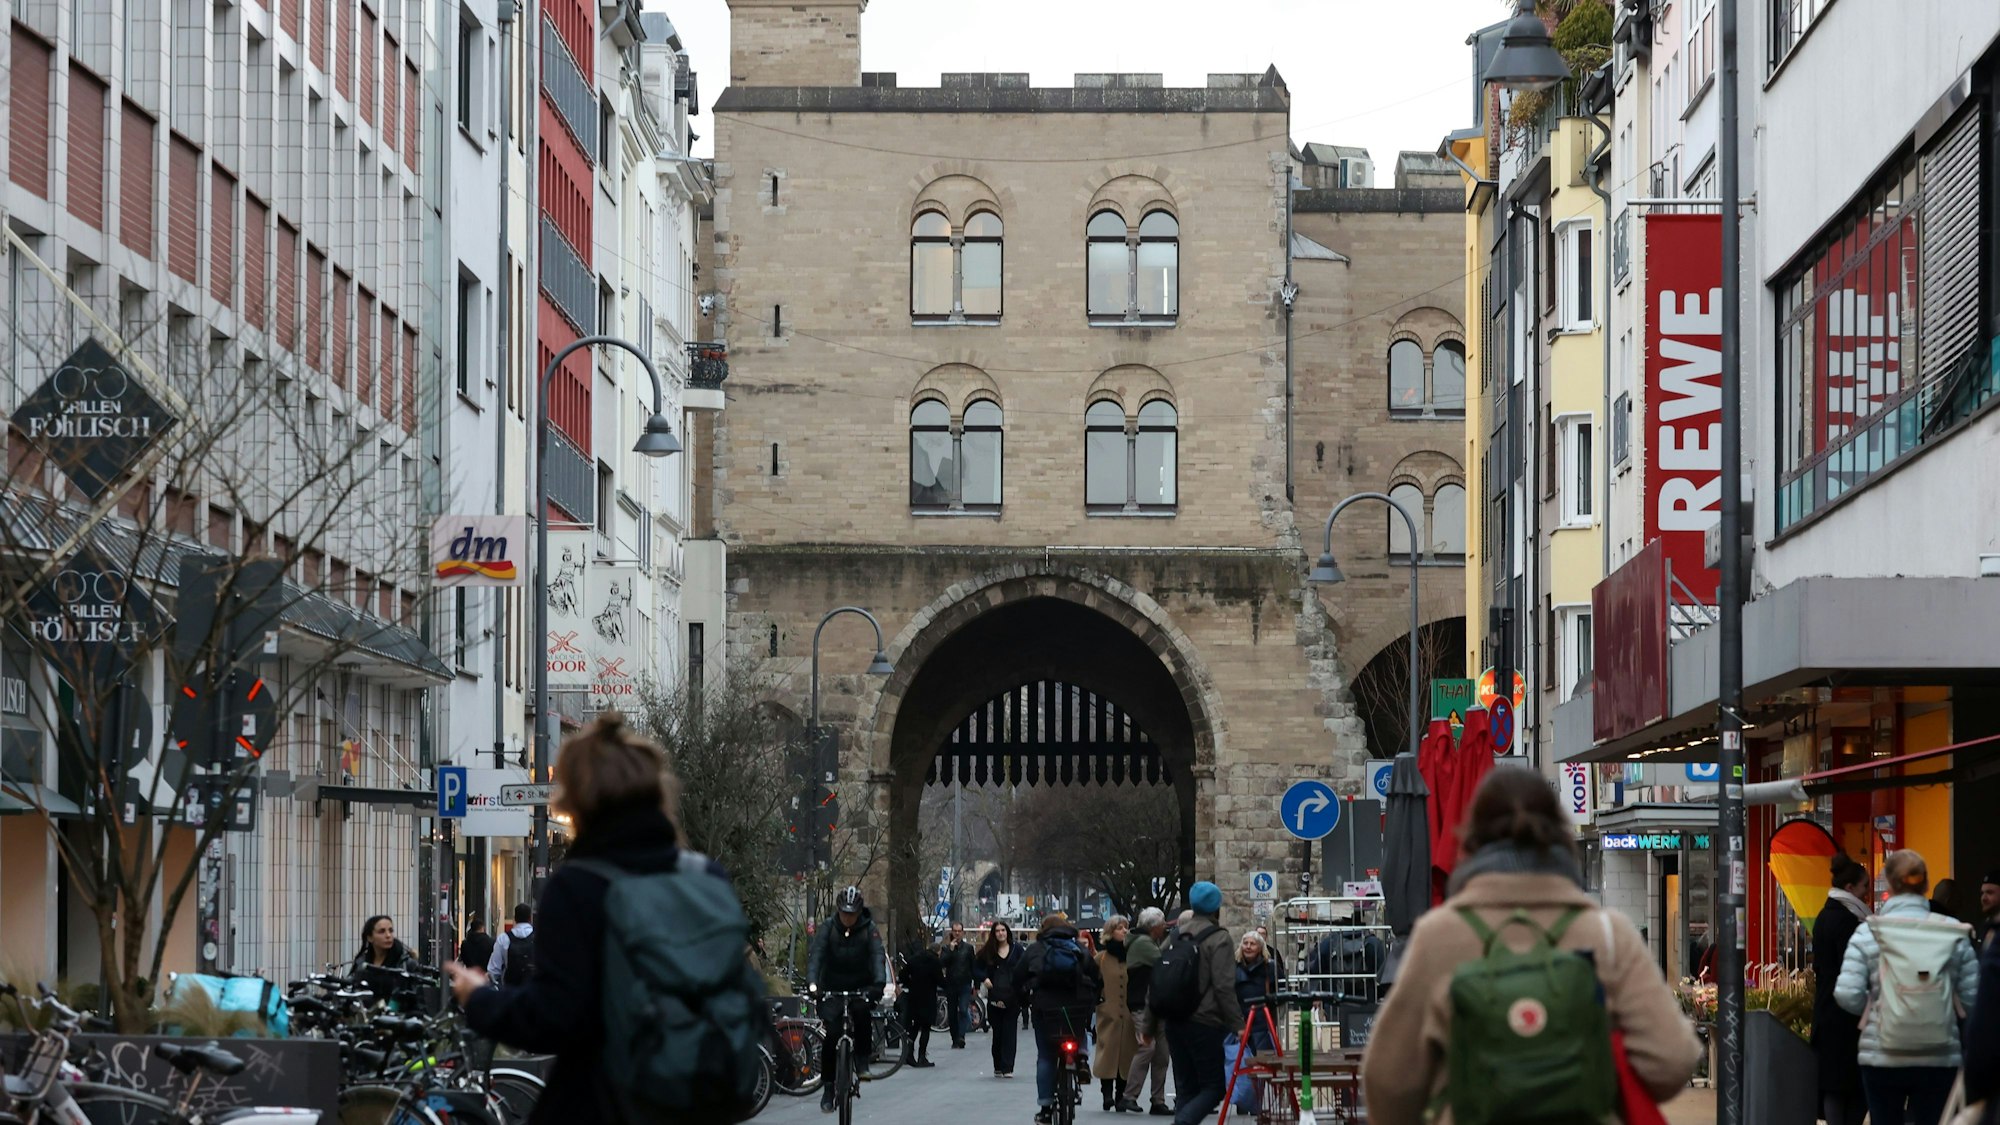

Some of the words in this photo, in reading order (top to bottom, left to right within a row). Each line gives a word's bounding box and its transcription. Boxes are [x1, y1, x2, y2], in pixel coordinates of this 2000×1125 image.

[1657, 287, 1722, 531] REWE
[449, 527, 507, 560] dm
[593, 684, 632, 695] BOOR
[1438, 683, 1469, 698] THAI
[444, 773, 460, 811] P
